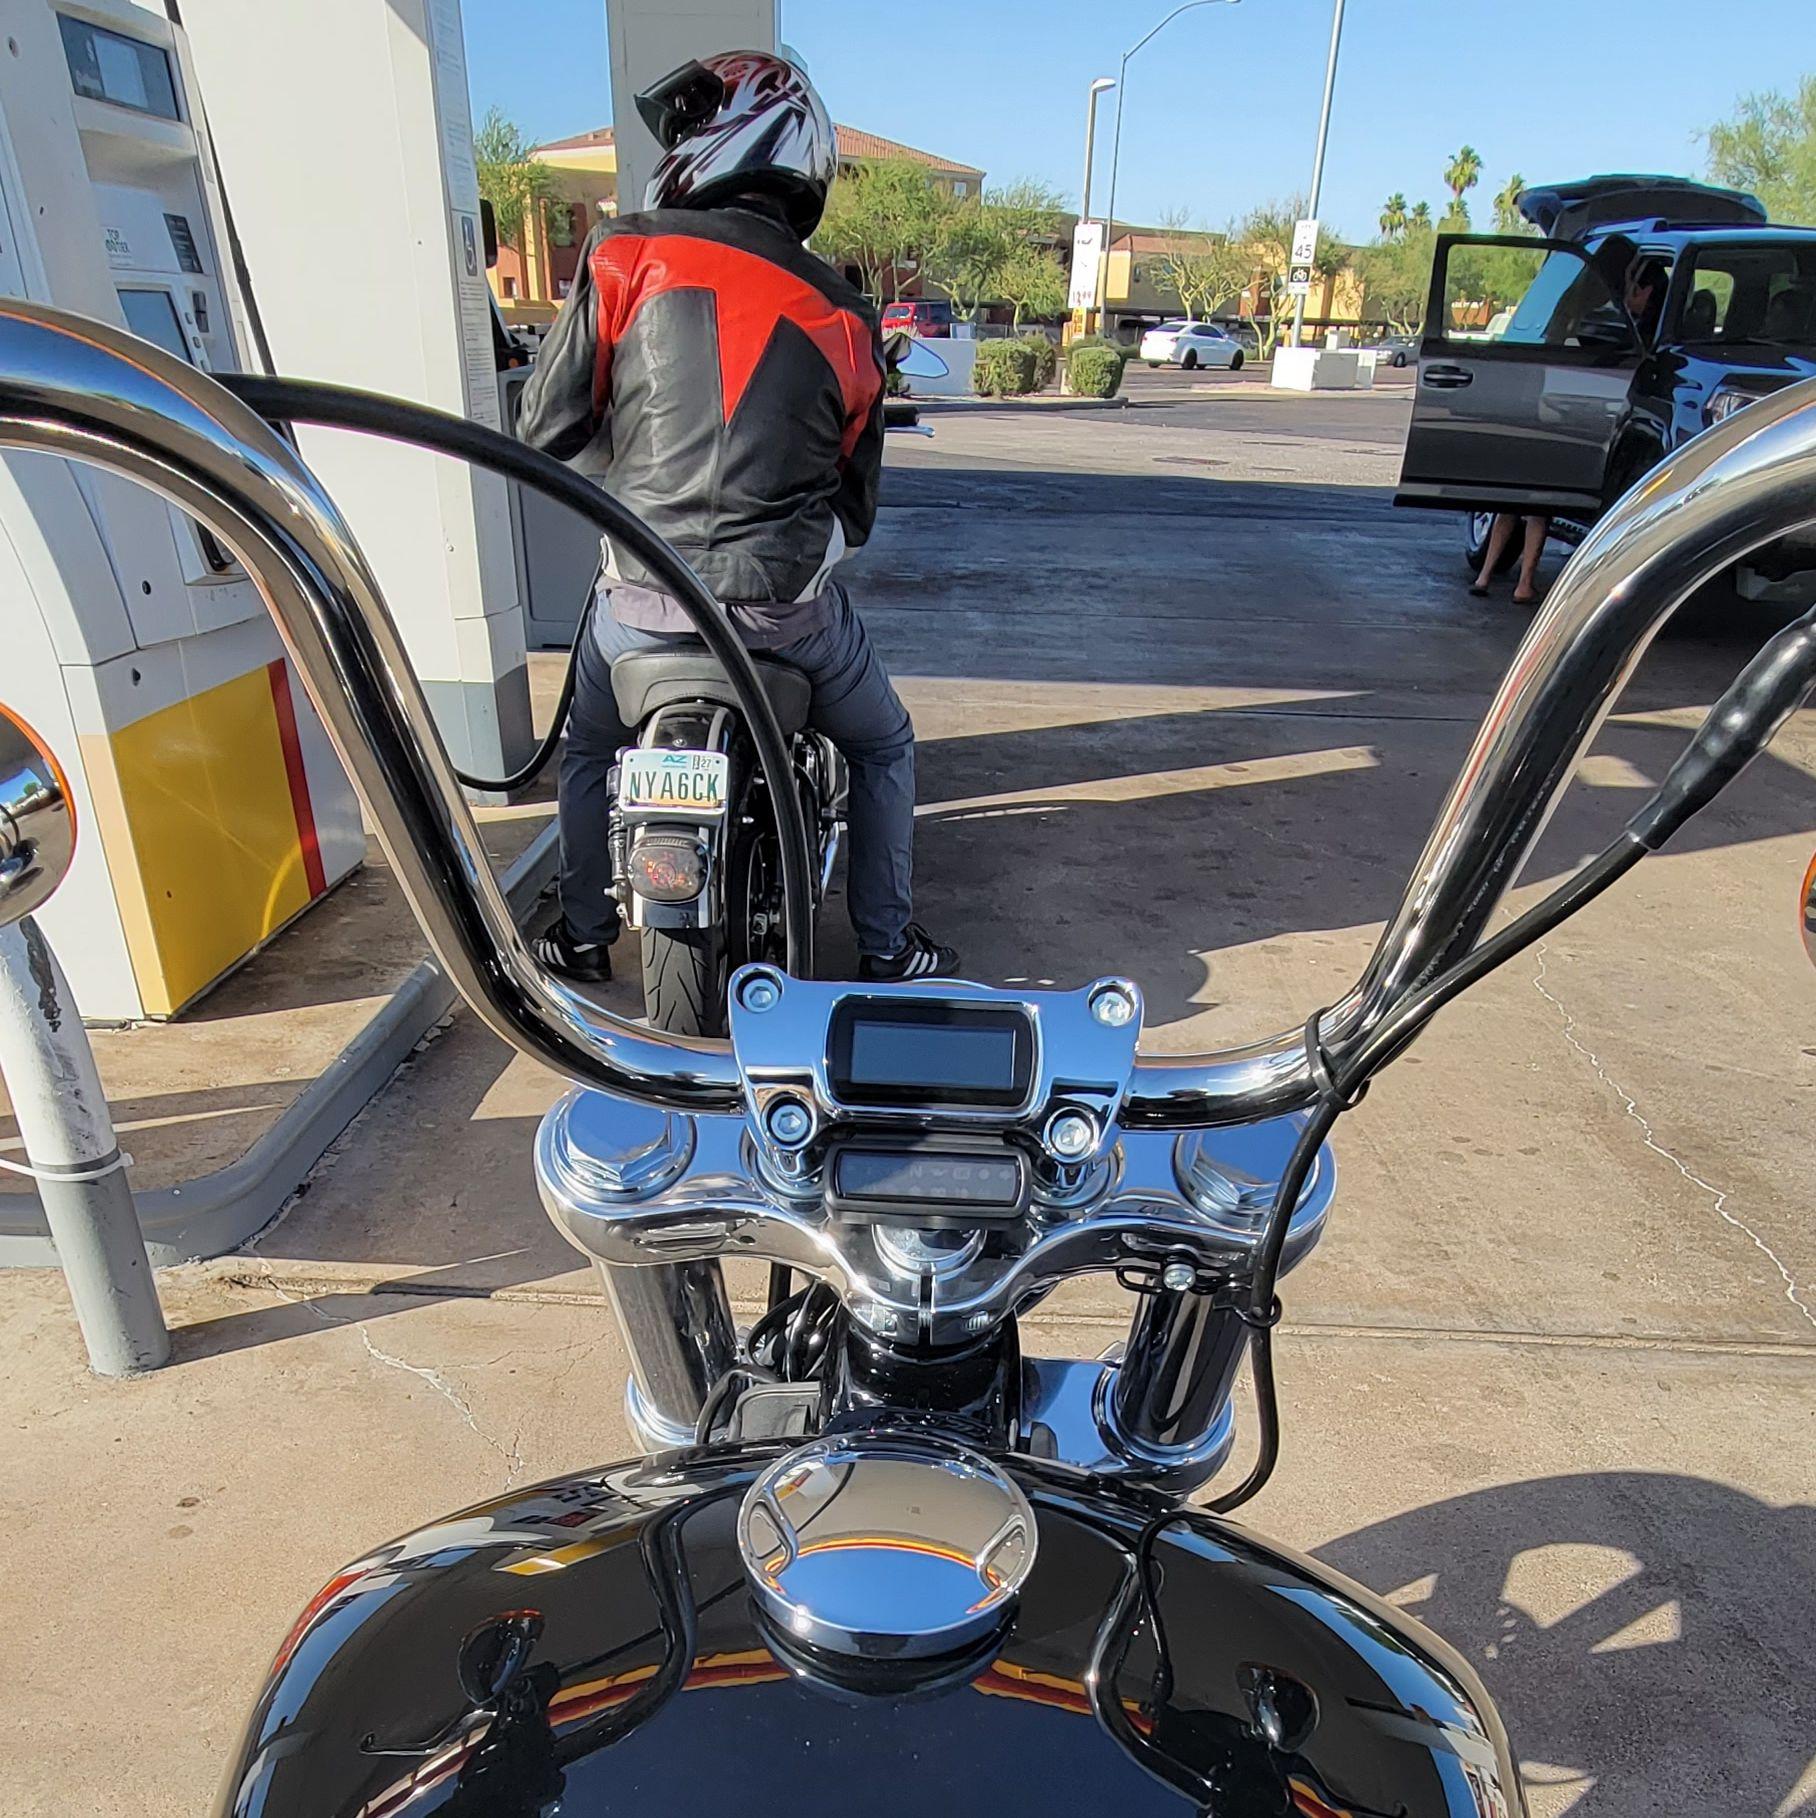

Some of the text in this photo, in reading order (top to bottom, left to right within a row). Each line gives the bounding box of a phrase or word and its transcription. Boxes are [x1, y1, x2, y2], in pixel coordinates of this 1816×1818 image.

[1294, 243, 1312, 259] 45
[662, 754, 688, 763] AZ
[700, 758, 711, 768] 27
[630, 771, 719, 802] NYA6CK
